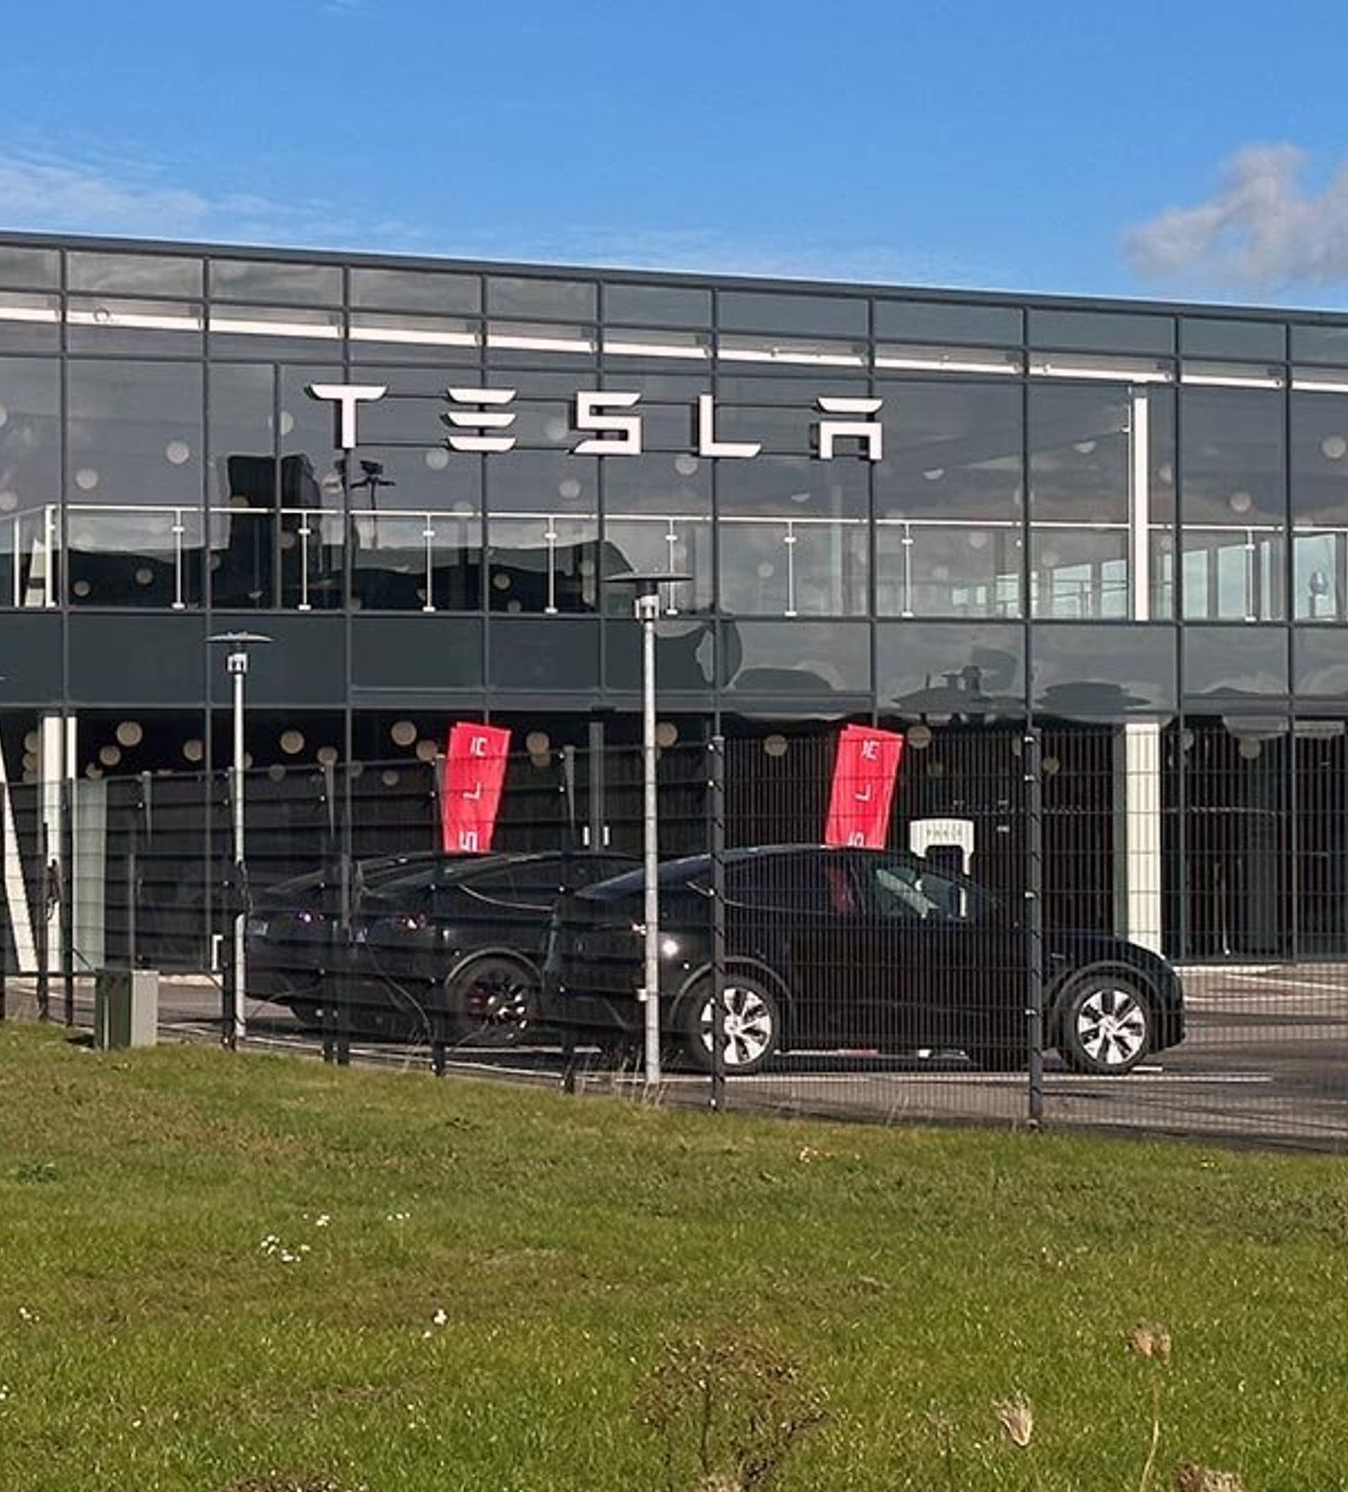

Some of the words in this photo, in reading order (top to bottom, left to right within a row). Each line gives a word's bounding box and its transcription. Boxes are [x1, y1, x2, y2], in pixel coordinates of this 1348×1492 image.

[310, 384, 883, 460] TESLA
[460, 736, 487, 852] SLA
[846, 740, 880, 848] SLA
